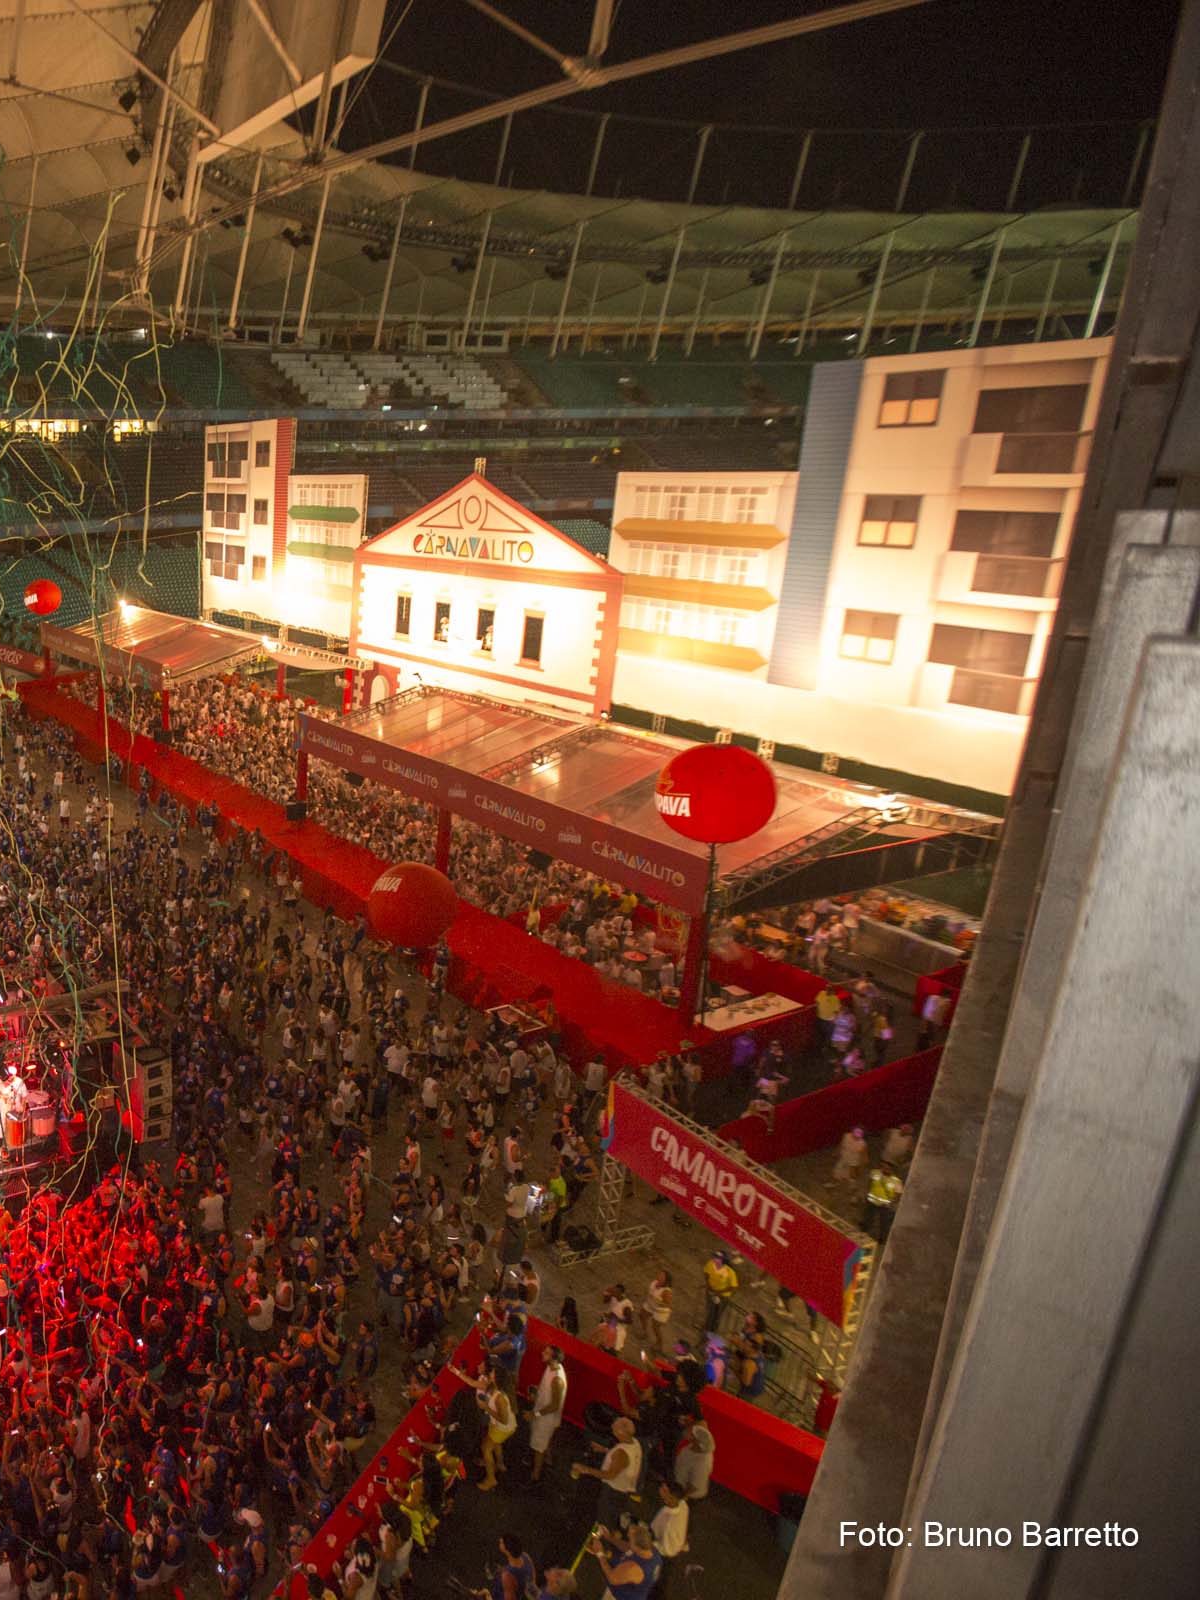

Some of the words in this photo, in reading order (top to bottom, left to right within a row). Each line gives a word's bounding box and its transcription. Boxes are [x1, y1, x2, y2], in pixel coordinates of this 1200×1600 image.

[413, 531, 534, 563] CARNAVALITO
[382, 759, 439, 789] CARNAVALITO
[474, 793, 546, 832] CARNAVALITO
[591, 840, 686, 888] CARNAVALITO
[650, 1126, 795, 1248] CAMAROTE
